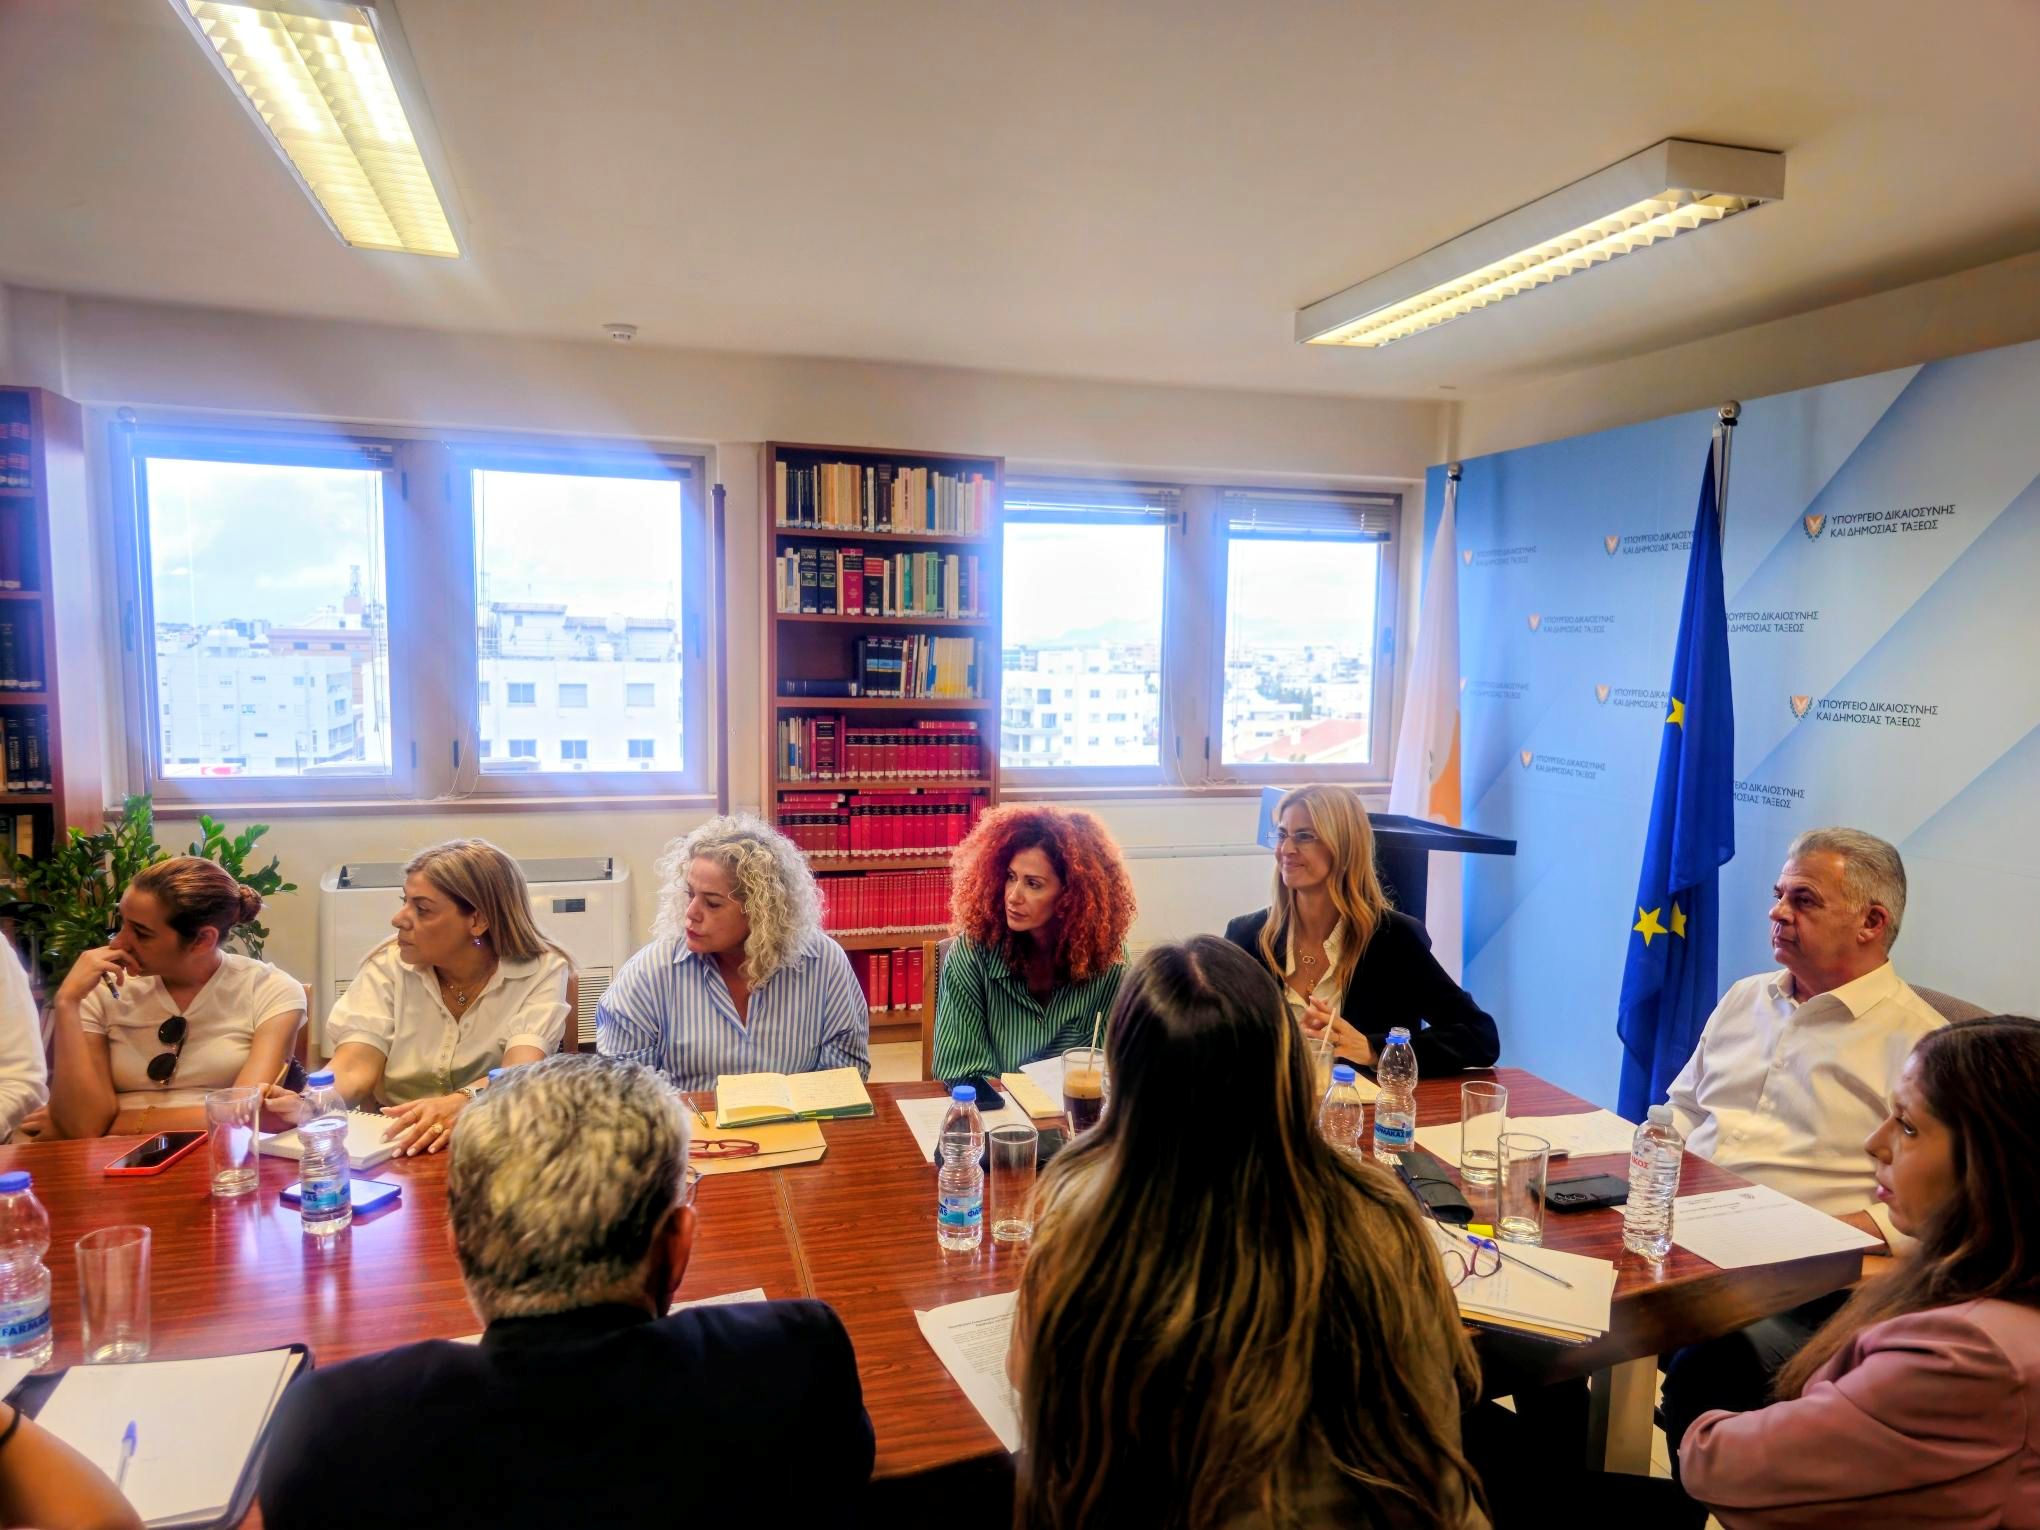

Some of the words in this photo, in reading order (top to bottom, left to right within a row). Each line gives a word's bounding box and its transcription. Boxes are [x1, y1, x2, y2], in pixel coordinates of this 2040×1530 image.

[1832, 511, 1882, 525] ΥΠΟΥΡΓΕΙΟ
[1885, 504, 1956, 520] ΔΙΚΑΙΟΣΥΝΗΣ
[1661, 530, 1694, 541] ΔΙΚΑΙΟΣΥ
[1830, 527, 1845, 538] ΚΑΙ
[1847, 523, 1898, 537] ΔΗΜΟΣΙΑΣ
[1901, 520, 1938, 532] ΤΑΞΕΩΣ
[1727, 612, 1760, 621] ΟΥΡΓΕΙΟ
[1761, 611, 1819, 621] ΔΙΚΑΙΟΣΥΝΗΣ
[1730, 624, 1771, 632] ΔΗΜΟΣΙΑΣ
[1774, 623, 1804, 632] ΤΑΞΕΩΣ
[1818, 699, 1868, 711] ΥΠΟΥΡΓΕΙΟ
[1869, 702, 1938, 715] ΔΙΚΑΙΟΣΥΝΗΣ
[1816, 711, 1831, 721] ΚΑΙ
[1832, 713, 1882, 725] ΔΗΜΟΣΙΑΣ
[1885, 716, 1921, 728] ΤΑΞΕΩΣ
[1749, 783, 1805, 799] ΔΙΚΑΙΟΣΥΝΗΣ
[1761, 796, 1792, 808] ΤΑΞΕΩΣ
